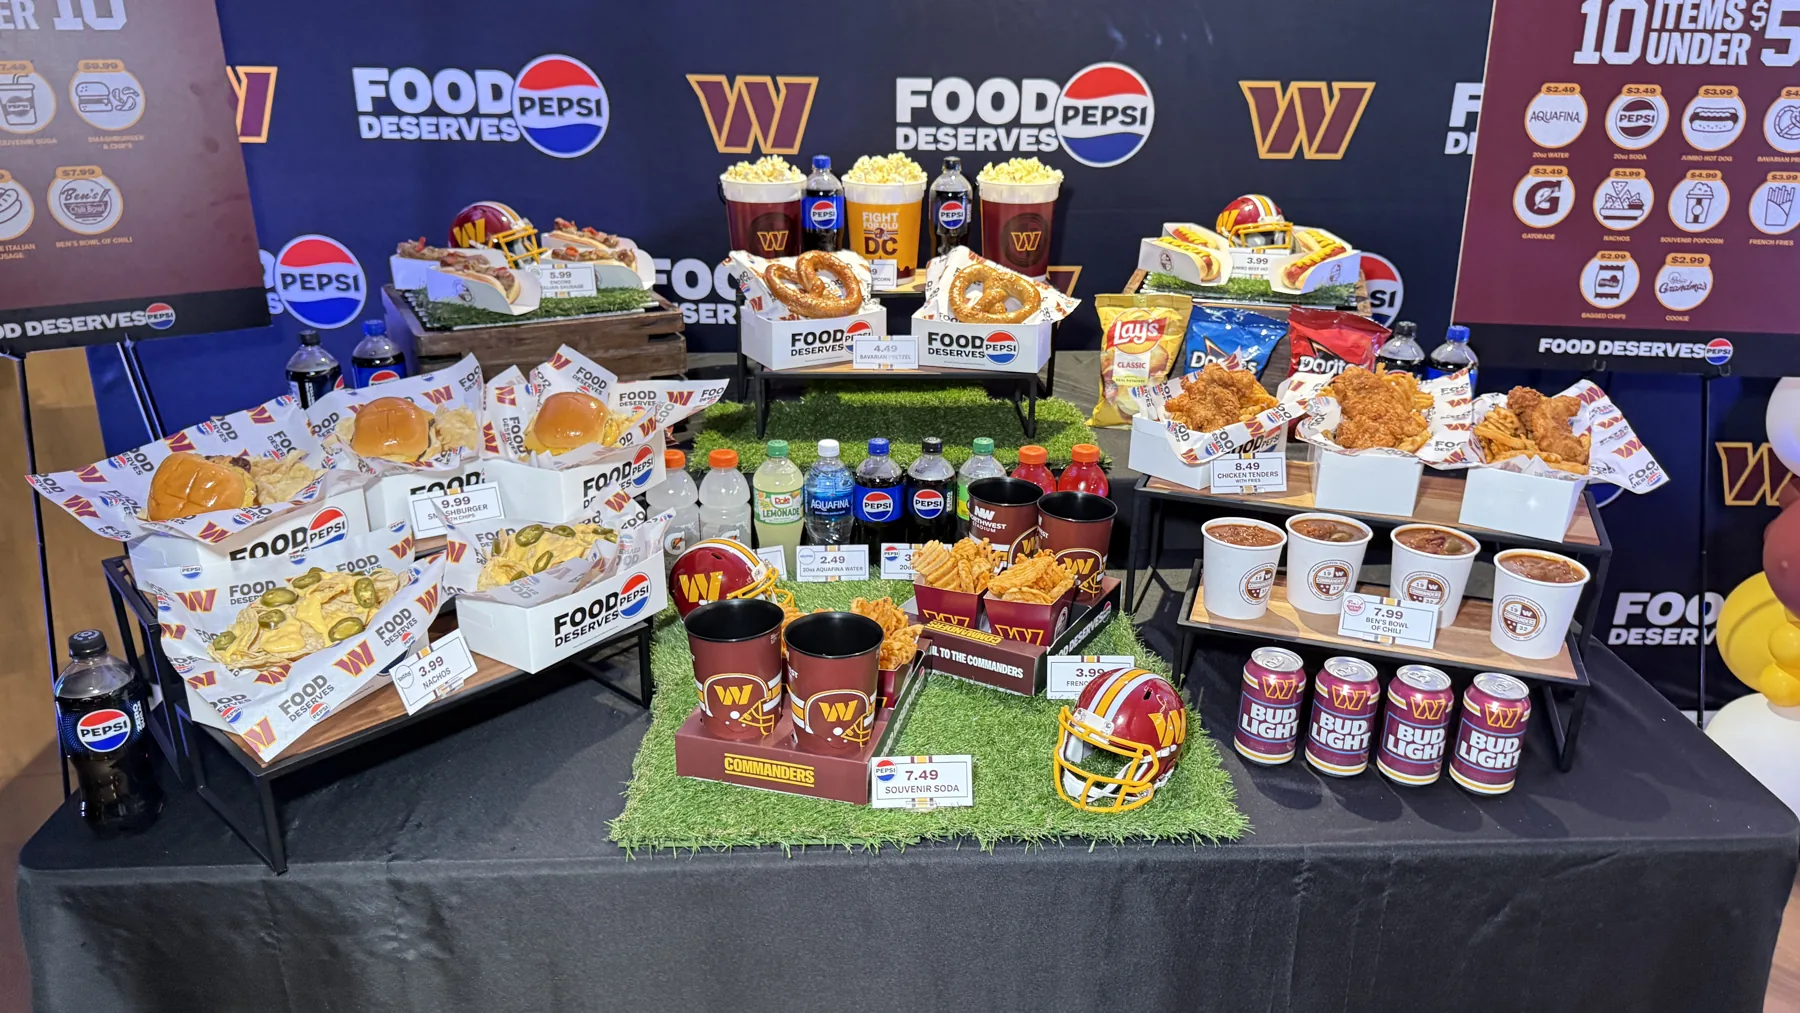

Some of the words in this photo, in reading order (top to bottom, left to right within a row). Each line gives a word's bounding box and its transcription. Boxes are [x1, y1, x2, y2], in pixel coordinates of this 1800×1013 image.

[1650, 0, 1745, 31] ITEMS
[1573, 0, 1649, 65] 10
[1645, 32, 1752, 65] UNDER
[352, 67, 515, 116] FOOD
[895, 77, 1058, 124] FOOD
[1626, 87, 1656, 95] $3.49
[1703, 88, 1733, 96] $3.99
[518, 96, 603, 118] PEPSI
[1061, 104, 1147, 128] PEPSI
[1529, 110, 1582, 123] AQUAFINA
[358, 115, 520, 142] DESERVES
[1619, 114, 1656, 123] PEPSI
[896, 127, 1060, 152] DESERVES
[862, 211, 899, 223] FIGHT
[864, 236, 899, 256] DC
[1247, 257, 1269, 265] 3.99
[1671, 256, 1705, 264] $2.99
[281, 272, 360, 294] PEPSI
[549, 271, 572, 279] 5.99
[25, 311, 146, 337] DESERVES
[1114, 319, 1159, 345] Lay's
[791, 329, 845, 348] FOOD
[928, 332, 984, 349] FOOD
[985, 344, 1017, 353] PEPSI
[1538, 338, 1596, 355] FOOD
[1598, 339, 1705, 358] DESERVES
[791, 344, 843, 357] DESERVES
[873, 345, 898, 353] 4.49
[928, 347, 985, 359] DESERVES
[1117, 361, 1147, 370] CLASSIC
[572, 373, 604, 396] DESERVES
[576, 366, 608, 390] FOOD
[619, 390, 657, 401] FOOD
[1217, 471, 1247, 479] CHICKEN
[1248, 470, 1279, 478] TENDERS
[1235, 462, 1260, 471] 8.49
[583, 461, 633, 498] FOOD
[632, 458, 654, 475] PEPSI
[441, 495, 471, 509] 9.99
[774, 496, 791, 505] Dole
[810, 498, 850, 510] AQUAFINA
[864, 501, 892, 510] PEPSI
[915, 500, 942, 508] PEPSI
[427, 503, 489, 521] SMSHBURGER
[458, 513, 476, 521] CHIPS
[762, 507, 800, 518] LEMONADE
[972, 521, 996, 533] STADIUM
[229, 526, 309, 562] FOOD
[309, 520, 346, 544] PEPSI
[820, 556, 845, 564] 2.49
[619, 586, 650, 606] PEPSI
[553, 591, 620, 635] FOOD
[1374, 607, 1404, 620] 7.99
[1612, 591, 1725, 627] FOO
[375, 607, 412, 641] FOOD
[384, 617, 418, 647] DESERVES
[554, 611, 619, 648] DESERVES
[1068, 612, 1105, 654] DESERVES
[1365, 617, 1387, 627] BEN'S
[1387, 620, 1409, 629] BOWL
[1371, 624, 1381, 632] OF
[1382, 625, 1402, 635] CHILI
[418, 655, 445, 678] 3.99
[940, 647, 950, 659] TO
[951, 650, 967, 664] THE
[967, 654, 1024, 679] COMMANDERS
[422, 667, 452, 690] NACHOS
[278, 674, 328, 717] FOOD
[288, 684, 335, 723] DESERVES
[1250, 702, 1297, 724] BUD
[1319, 711, 1368, 735] BUD
[81, 719, 128, 738] PEPSI
[1241, 715, 1299, 739] LIGHT
[1311, 723, 1371, 750] LIGHT
[1397, 723, 1445, 745] BUD
[1386, 734, 1446, 760] LIGHT
[1469, 730, 1519, 754] BUD
[1459, 740, 1520, 769] LIGHT
[724, 756, 815, 785] COMMANDERS
[905, 769, 939, 781] 7.49
[885, 784, 932, 794] SOUVENIR
[933, 783, 959, 793] SODA
